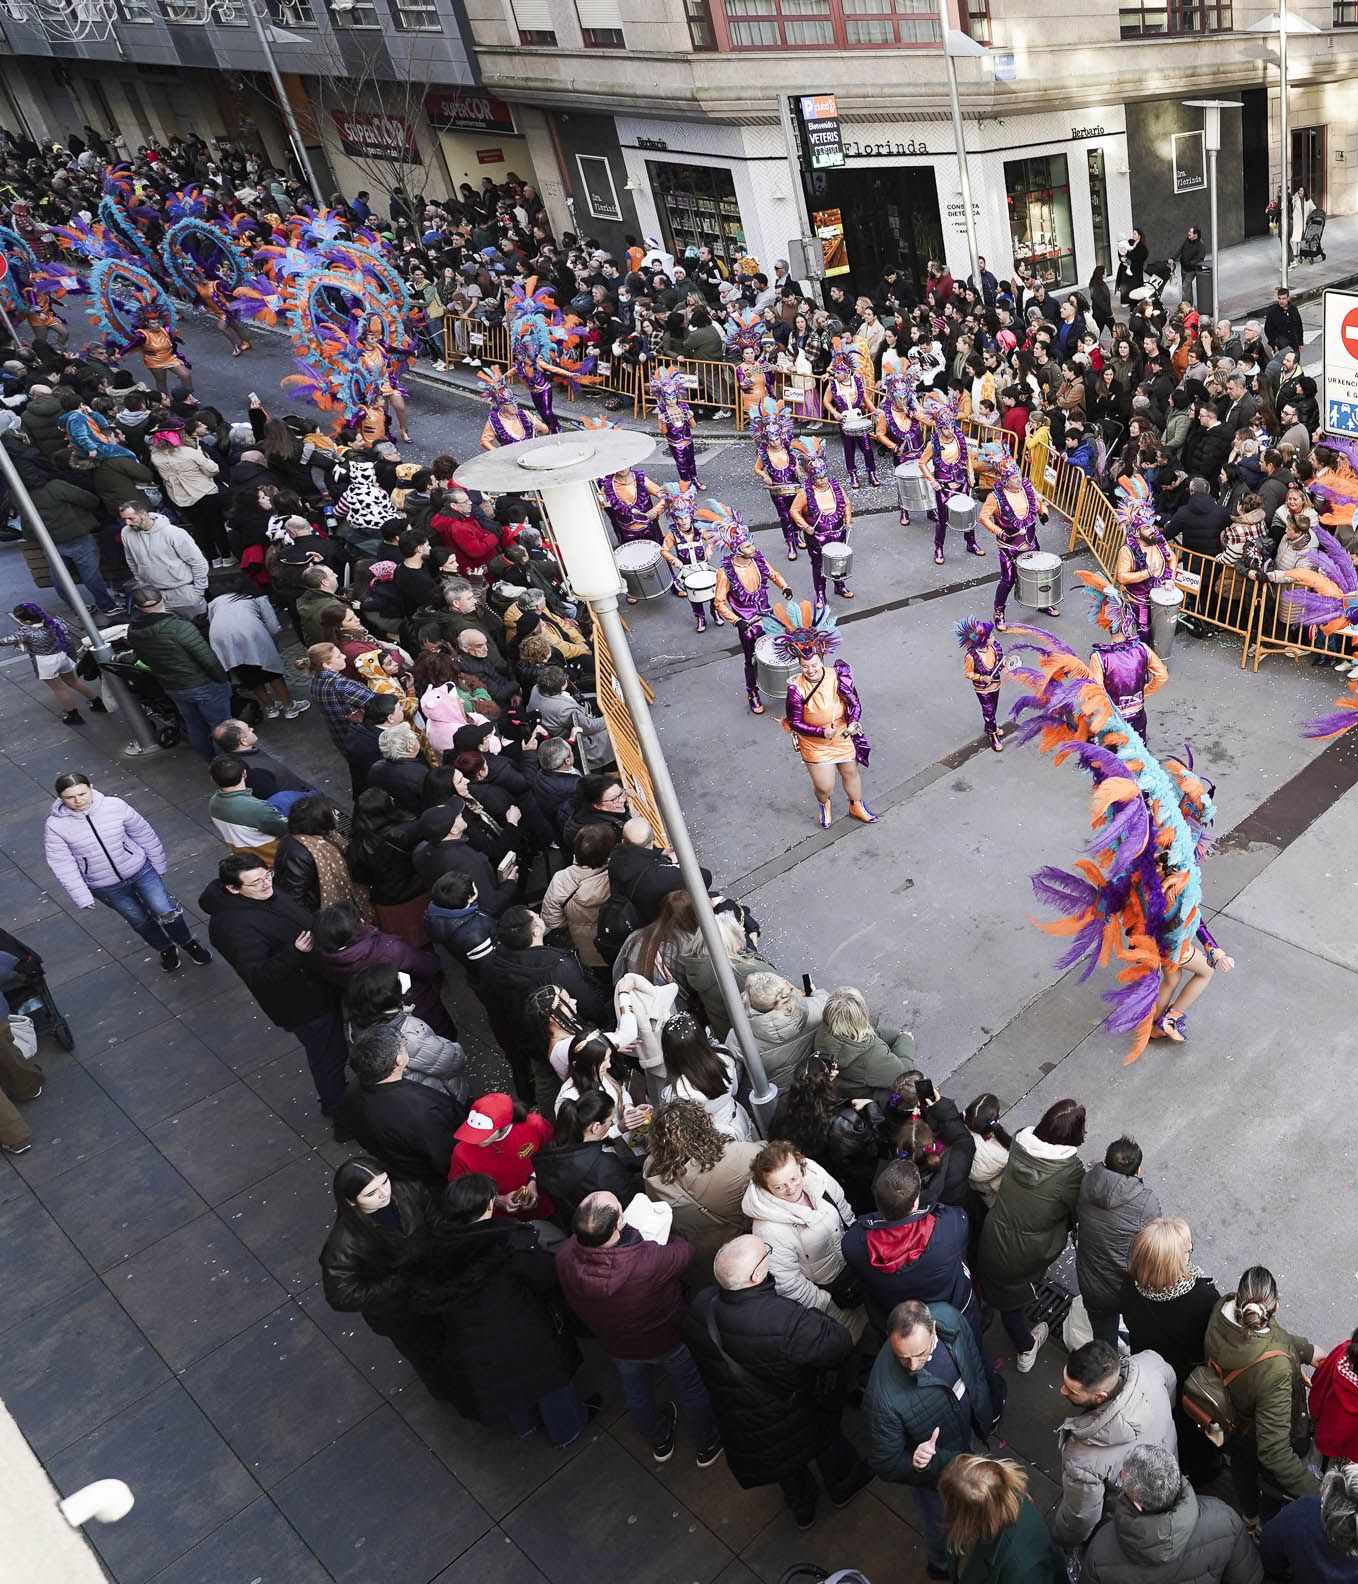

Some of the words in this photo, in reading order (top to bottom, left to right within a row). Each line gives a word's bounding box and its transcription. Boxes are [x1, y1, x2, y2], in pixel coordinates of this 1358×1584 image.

[443, 98, 495, 121] SUPERCOR
[808, 131, 839, 144] VETERIS
[844, 140, 929, 155] Florinda
